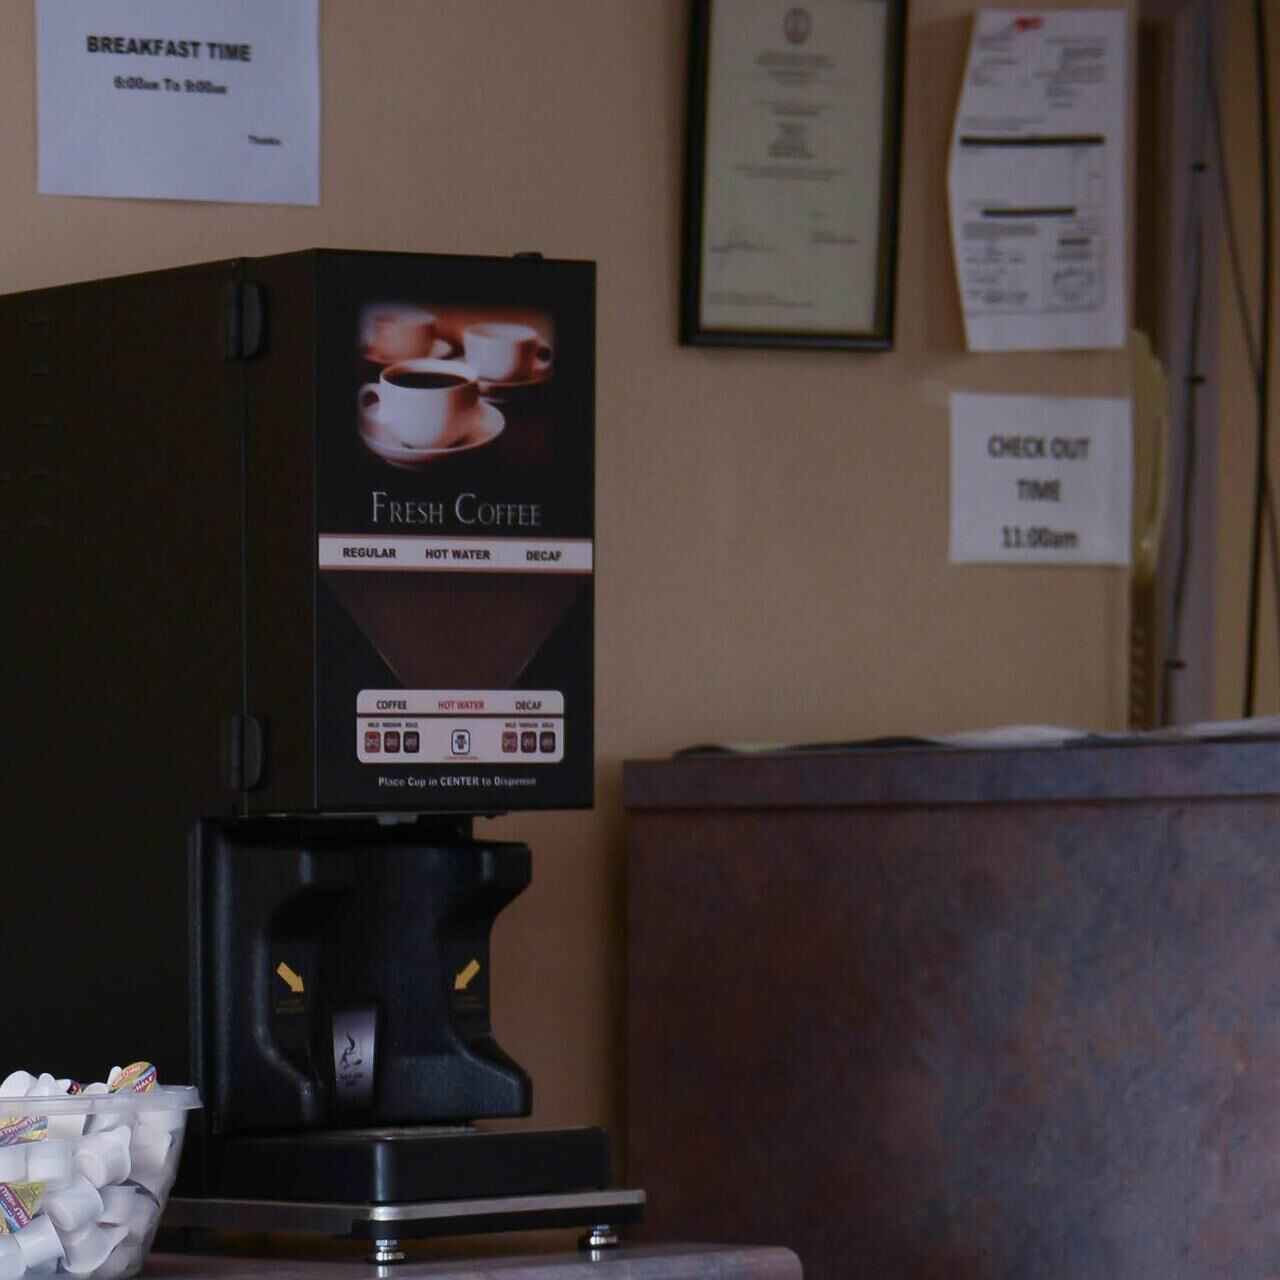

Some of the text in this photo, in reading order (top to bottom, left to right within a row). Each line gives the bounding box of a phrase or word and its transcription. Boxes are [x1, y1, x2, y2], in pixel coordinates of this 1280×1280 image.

[87, 35, 252, 62] BREAKFAST TIME
[163, 78, 180, 92] To
[987, 435, 1091, 460] CHECK OUT
[1017, 478, 1061, 502] TIME
[342, 547, 397, 559] REGULAR
[425, 549, 491, 561] HOT WATER
[526, 550, 562, 562] DECAF
[376, 700, 408, 711] COFFEE
[438, 701, 485, 711] HOT WATER
[515, 701, 542, 711] DECAF
[378, 777, 405, 787] Place
[407, 777, 426, 788] Cup
[428, 778, 438, 786] in
[440, 777, 479, 787] CENTER
[482, 777, 491, 786] to
